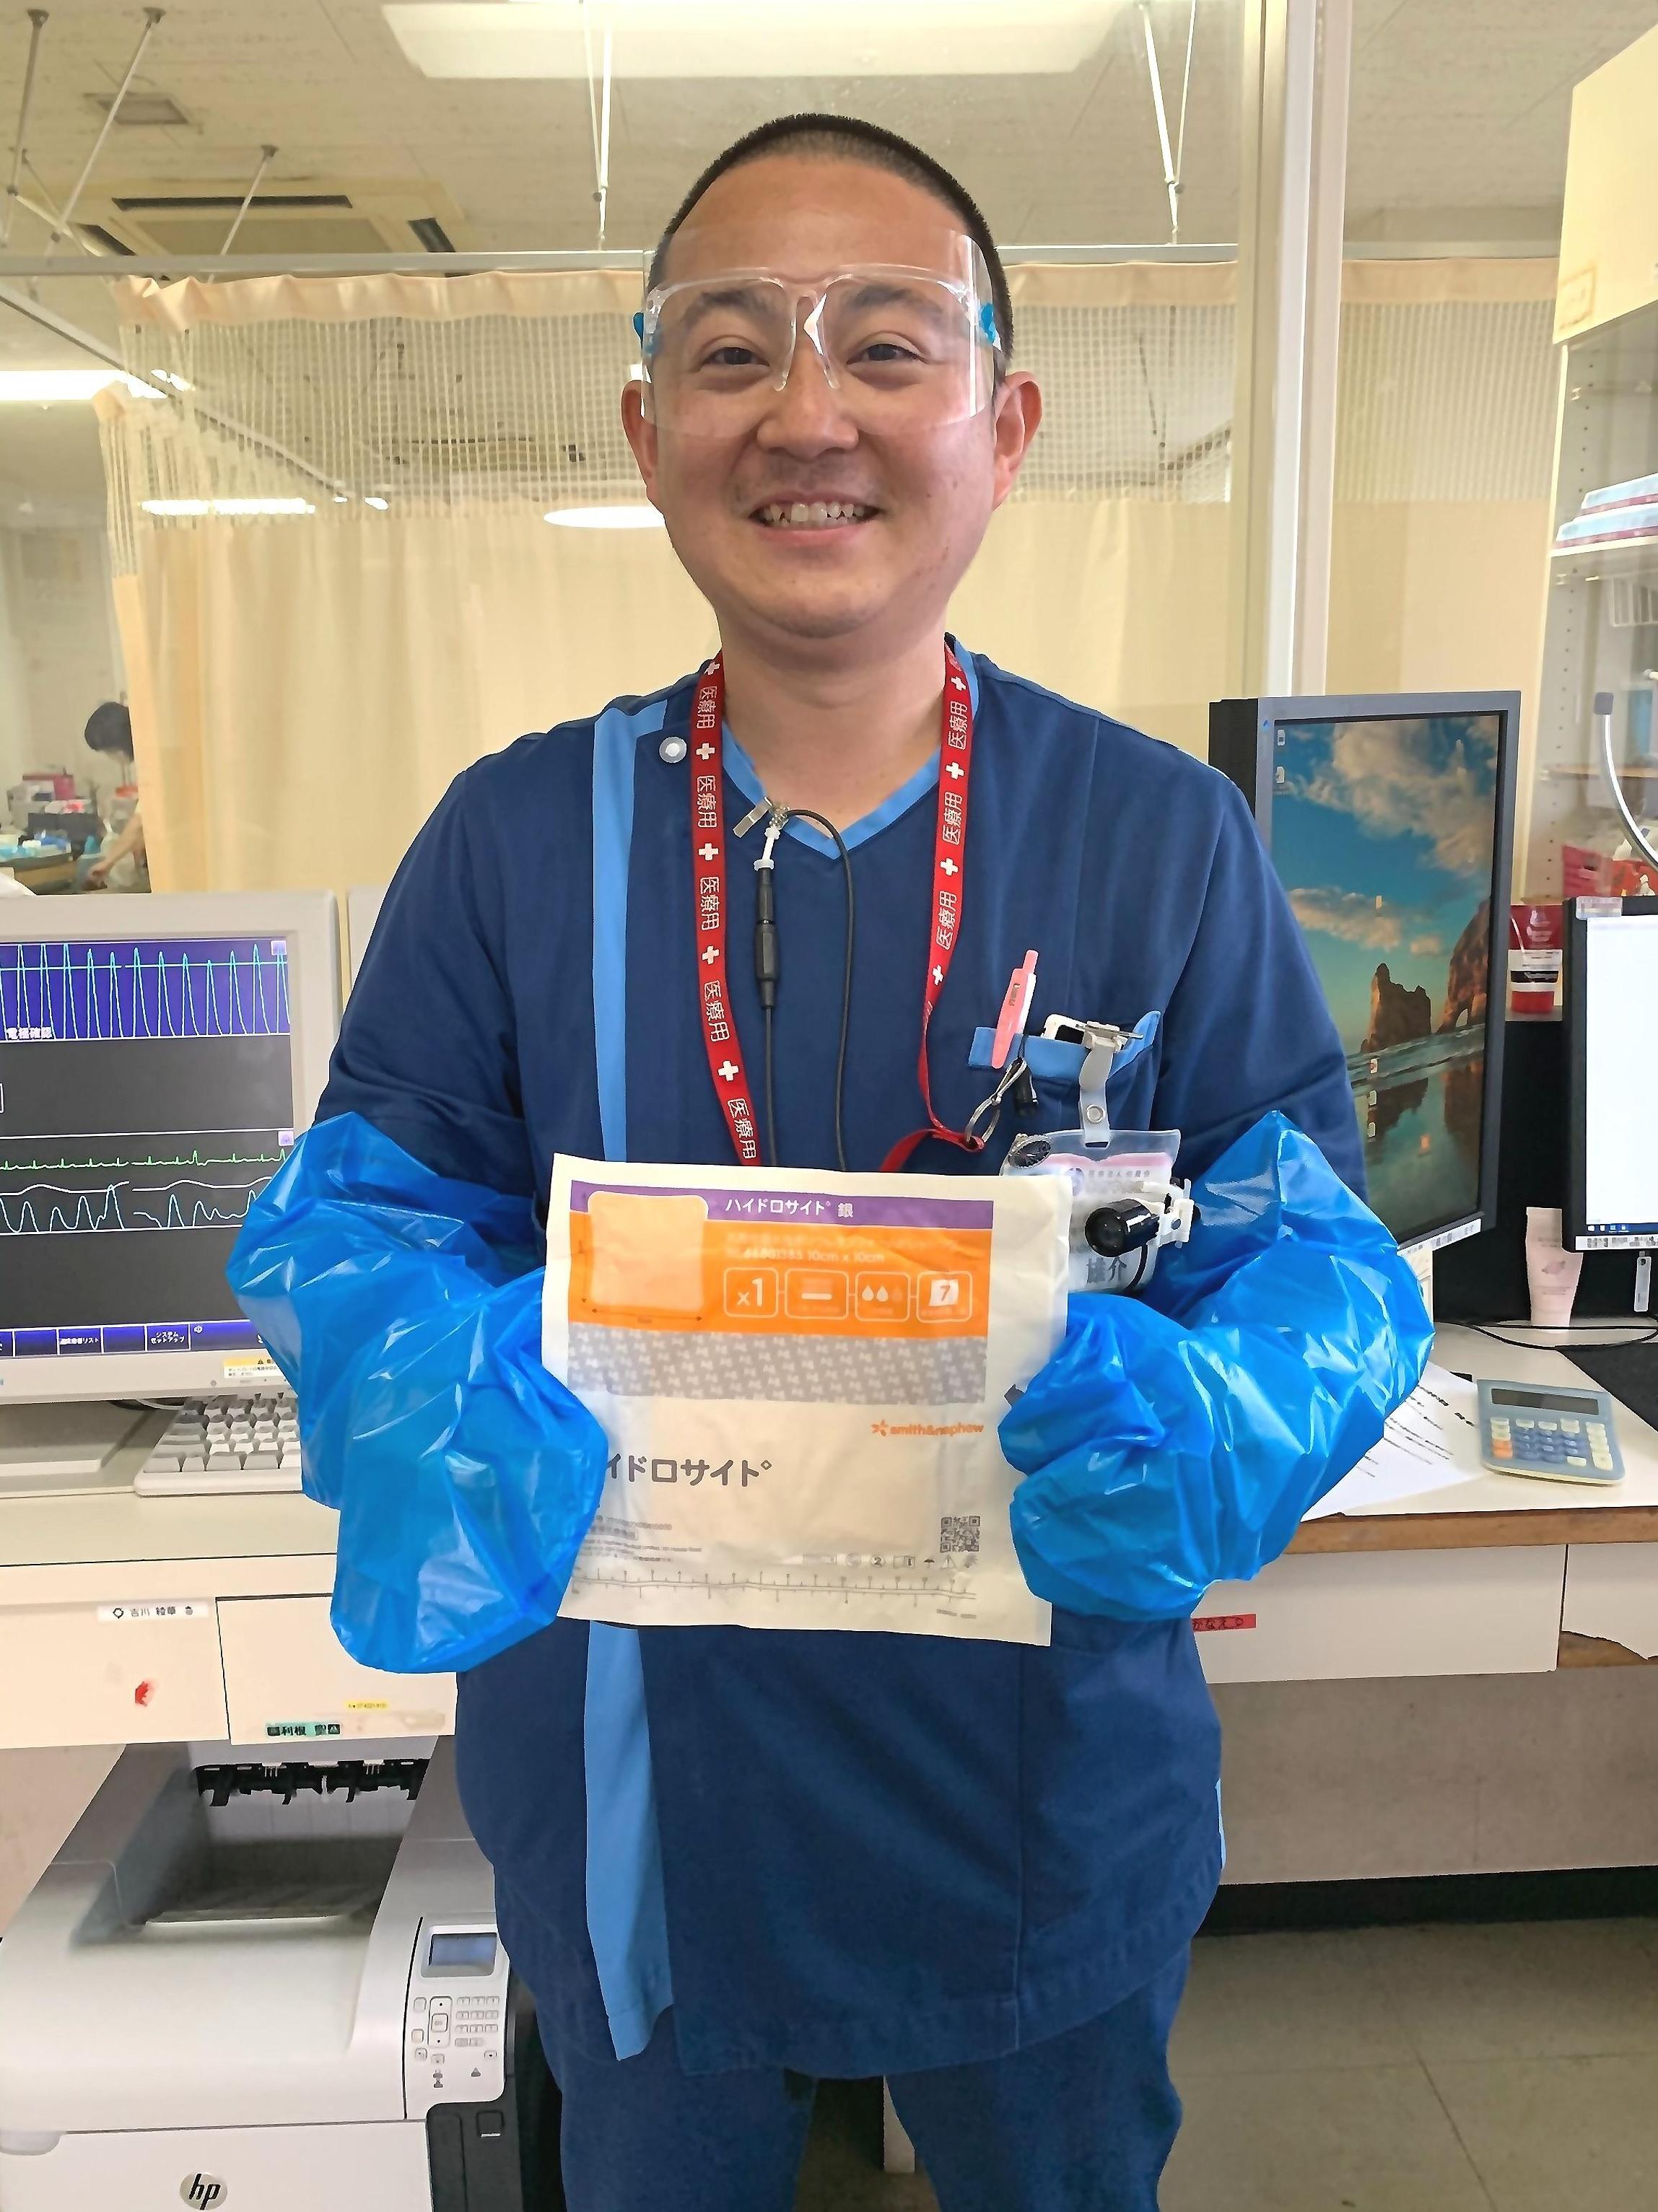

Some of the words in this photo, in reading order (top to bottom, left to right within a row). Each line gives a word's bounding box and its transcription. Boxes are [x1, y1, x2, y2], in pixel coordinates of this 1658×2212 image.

[697, 686, 717, 729] 医療用
[948, 701, 968, 750] 医療用
[697, 775, 717, 828] 医療用
[942, 791, 963, 845] 医療用
[700, 876, 720, 931] 医療用
[936, 890, 957, 950] 医療用
[704, 979, 730, 1042] 医療用
[727, 1098, 756, 1159] 医療用
[725, 1198, 825, 1216] ハイドロサイト
[938, 1284, 951, 1302] 7
[606, 1453, 759, 1487] イドロサイト
[188, 2173, 222, 2211] hp
